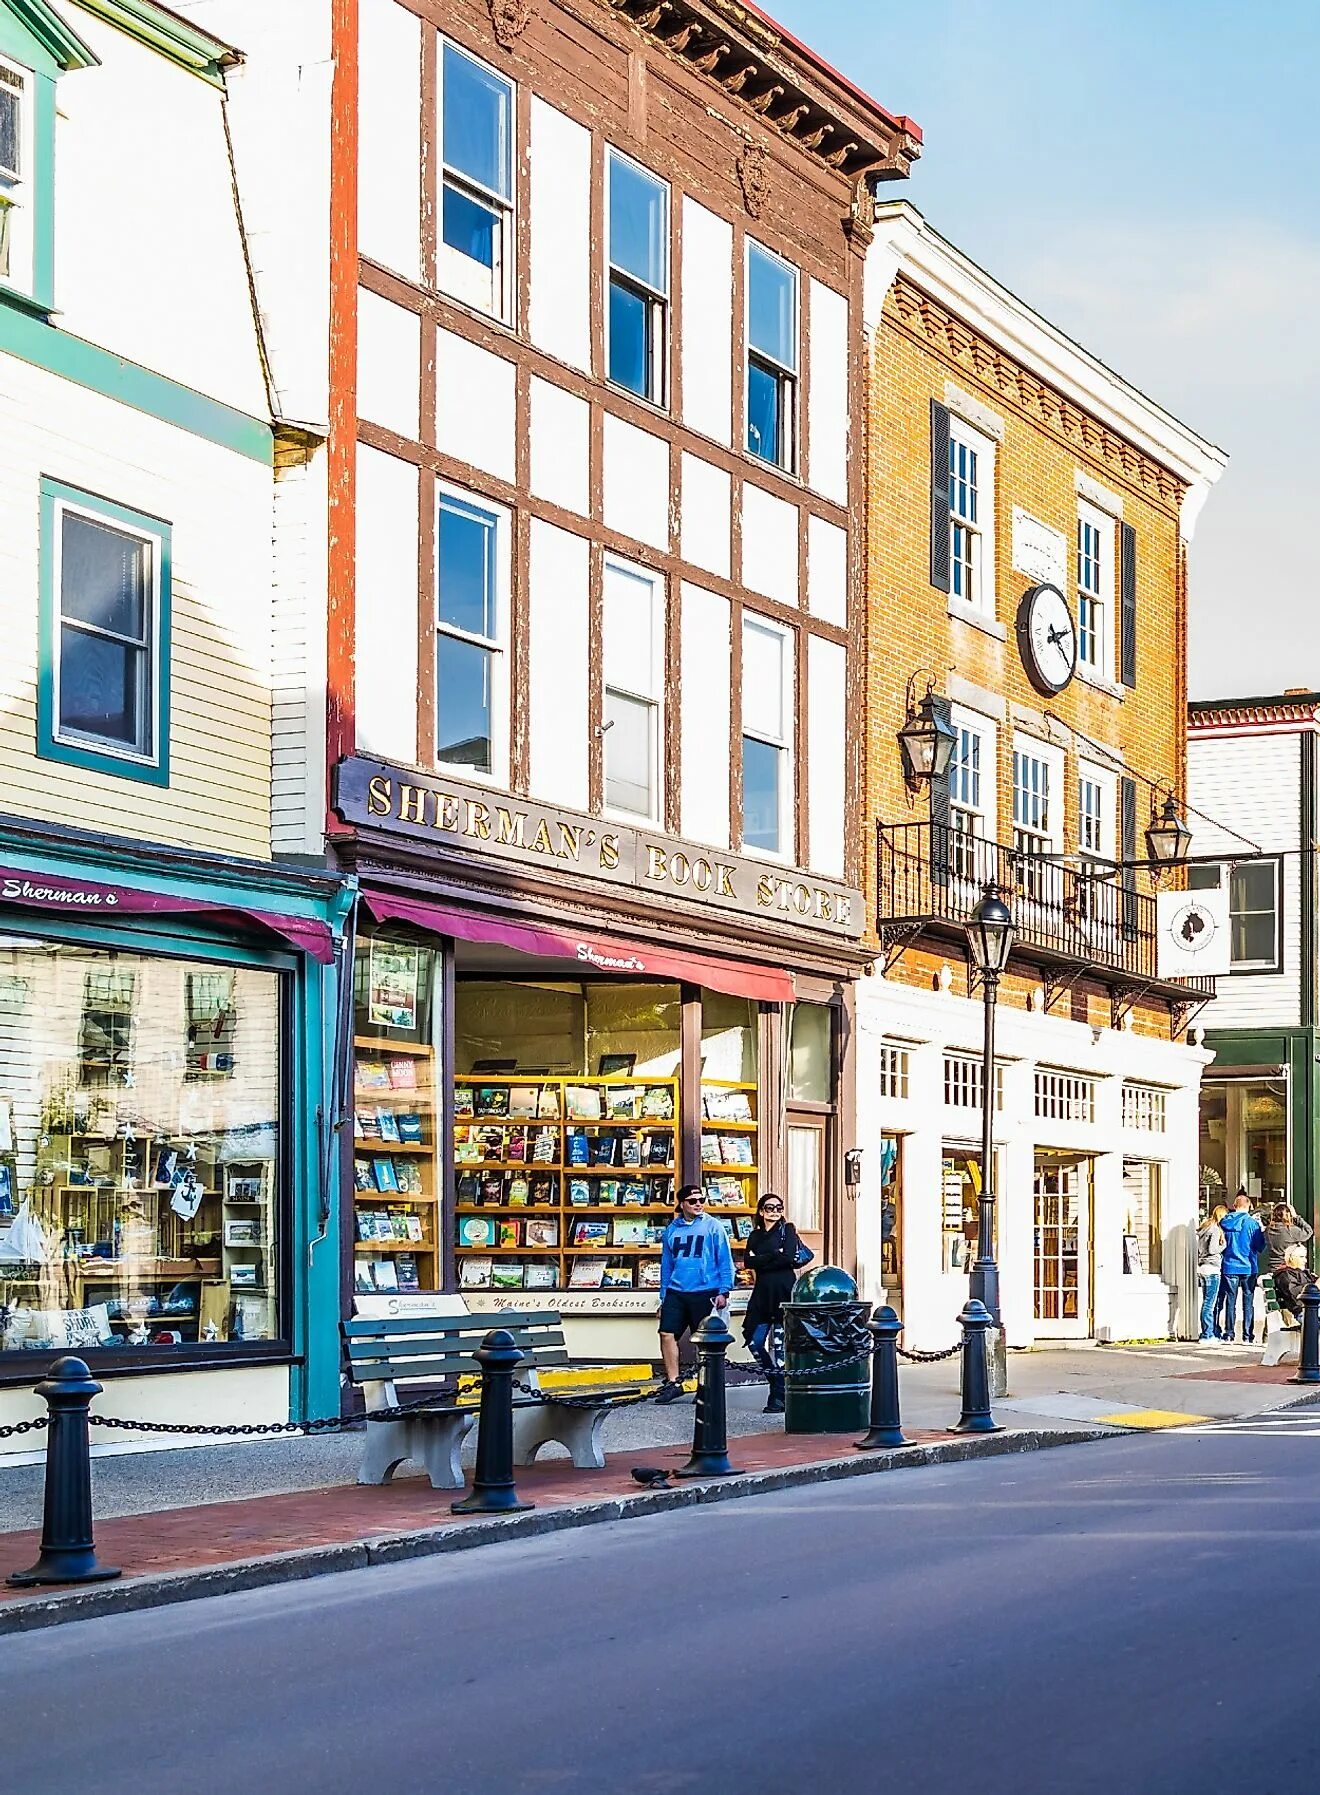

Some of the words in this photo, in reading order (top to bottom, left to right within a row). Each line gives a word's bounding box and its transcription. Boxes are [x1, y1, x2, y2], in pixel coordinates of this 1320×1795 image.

[368, 775, 619, 870] SHERMAN'S
[644, 844, 738, 899] BOOK
[757, 874, 851, 927] STORE
[672, 1234, 705, 1259] HI
[493, 1297, 541, 1308] Maine's
[547, 1297, 586, 1308] Oldest
[591, 1297, 648, 1308] Bookstore
[63, 1316, 99, 1332] SHORE
